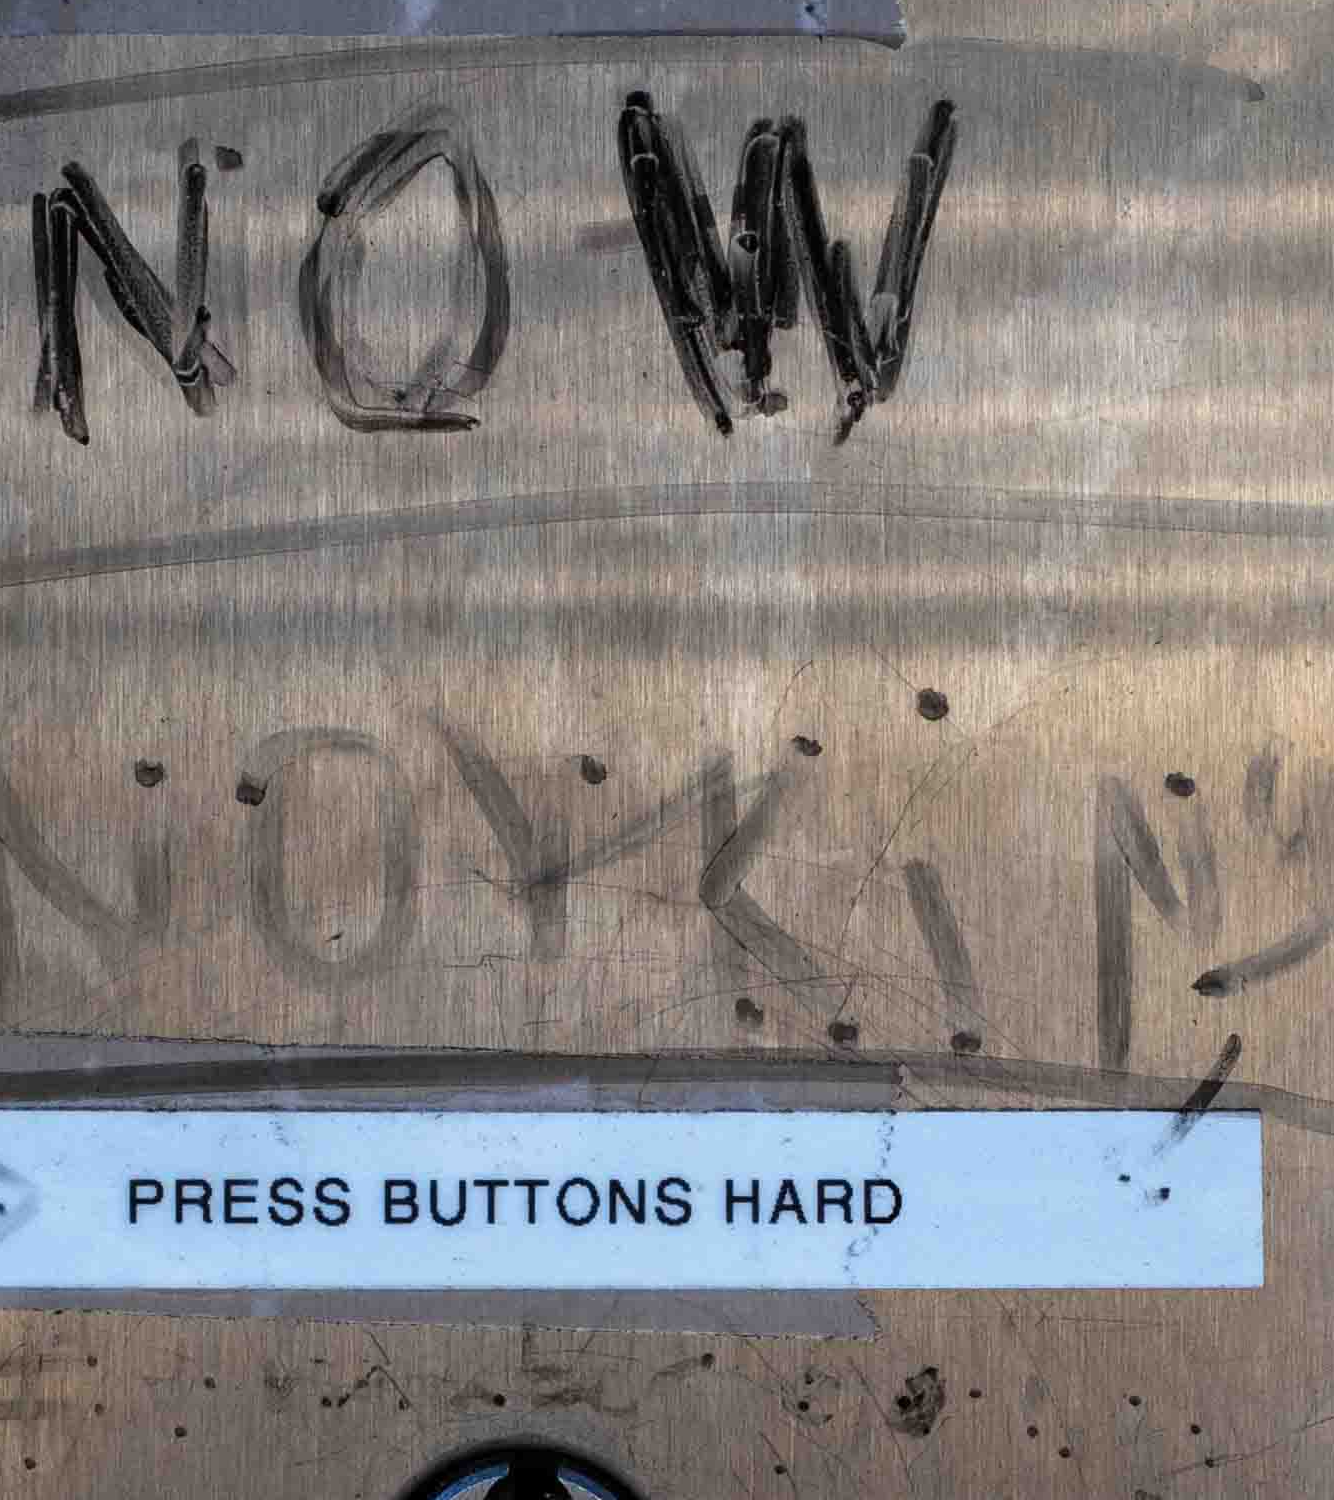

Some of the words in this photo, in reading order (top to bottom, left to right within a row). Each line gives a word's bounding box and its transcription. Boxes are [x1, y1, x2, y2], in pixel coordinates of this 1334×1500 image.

[32, 88, 957, 446] NOW
[128, 1177, 352, 1228] PRESS
[383, 1177, 695, 1228] BUTTONS
[724, 1177, 906, 1228] HARD
